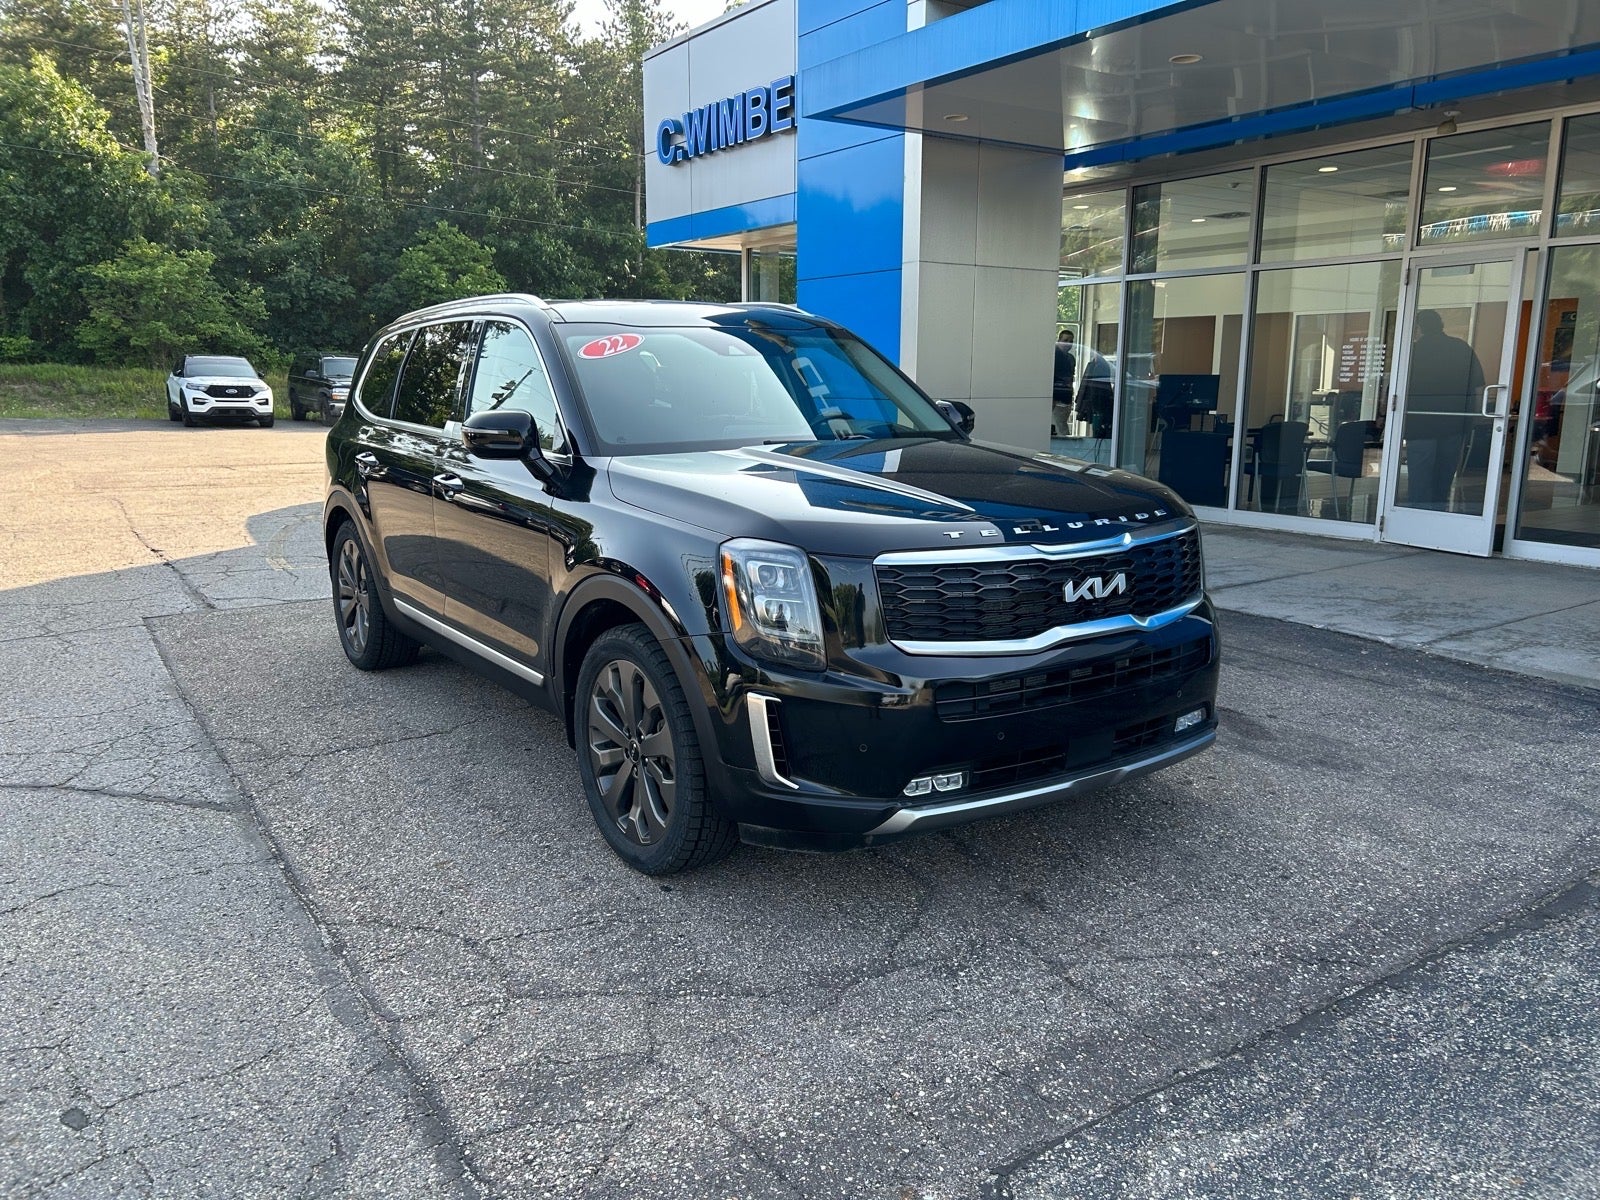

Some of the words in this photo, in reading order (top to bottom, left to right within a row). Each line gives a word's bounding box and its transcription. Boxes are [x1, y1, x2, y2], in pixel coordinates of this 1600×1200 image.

[656, 73, 798, 166] C.WIMBE
[598, 335, 628, 356] 22
[943, 508, 1168, 540] TELLURIDE
[1063, 572, 1126, 603] KIA
